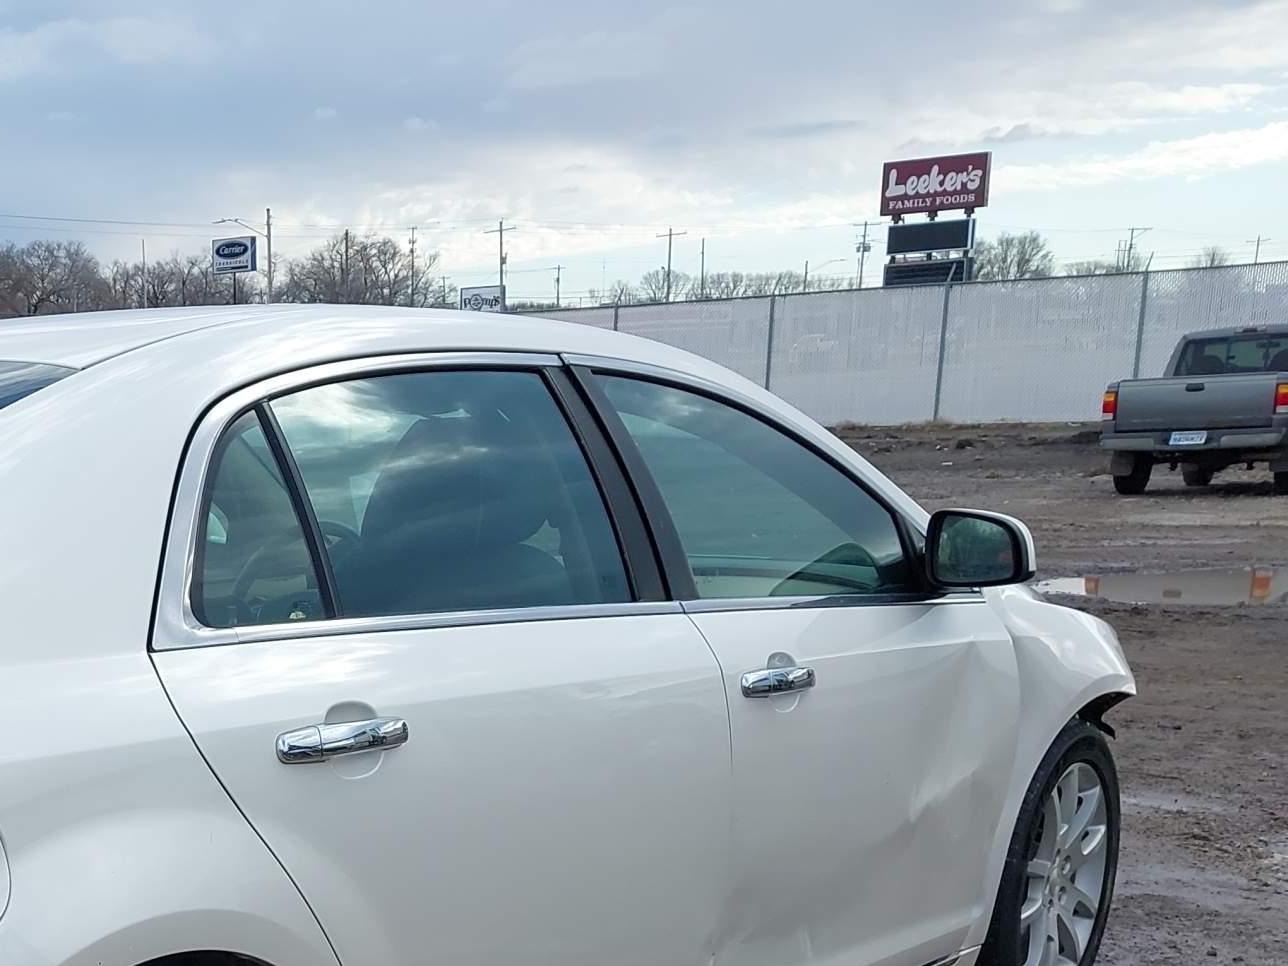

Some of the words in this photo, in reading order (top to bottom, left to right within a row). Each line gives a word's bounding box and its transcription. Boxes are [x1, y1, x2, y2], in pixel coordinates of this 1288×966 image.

[885, 164, 983, 198] Leeker's
[888, 198, 933, 209] FAMILY
[936, 194, 975, 206] FOODS
[220, 245, 244, 254] Carrier
